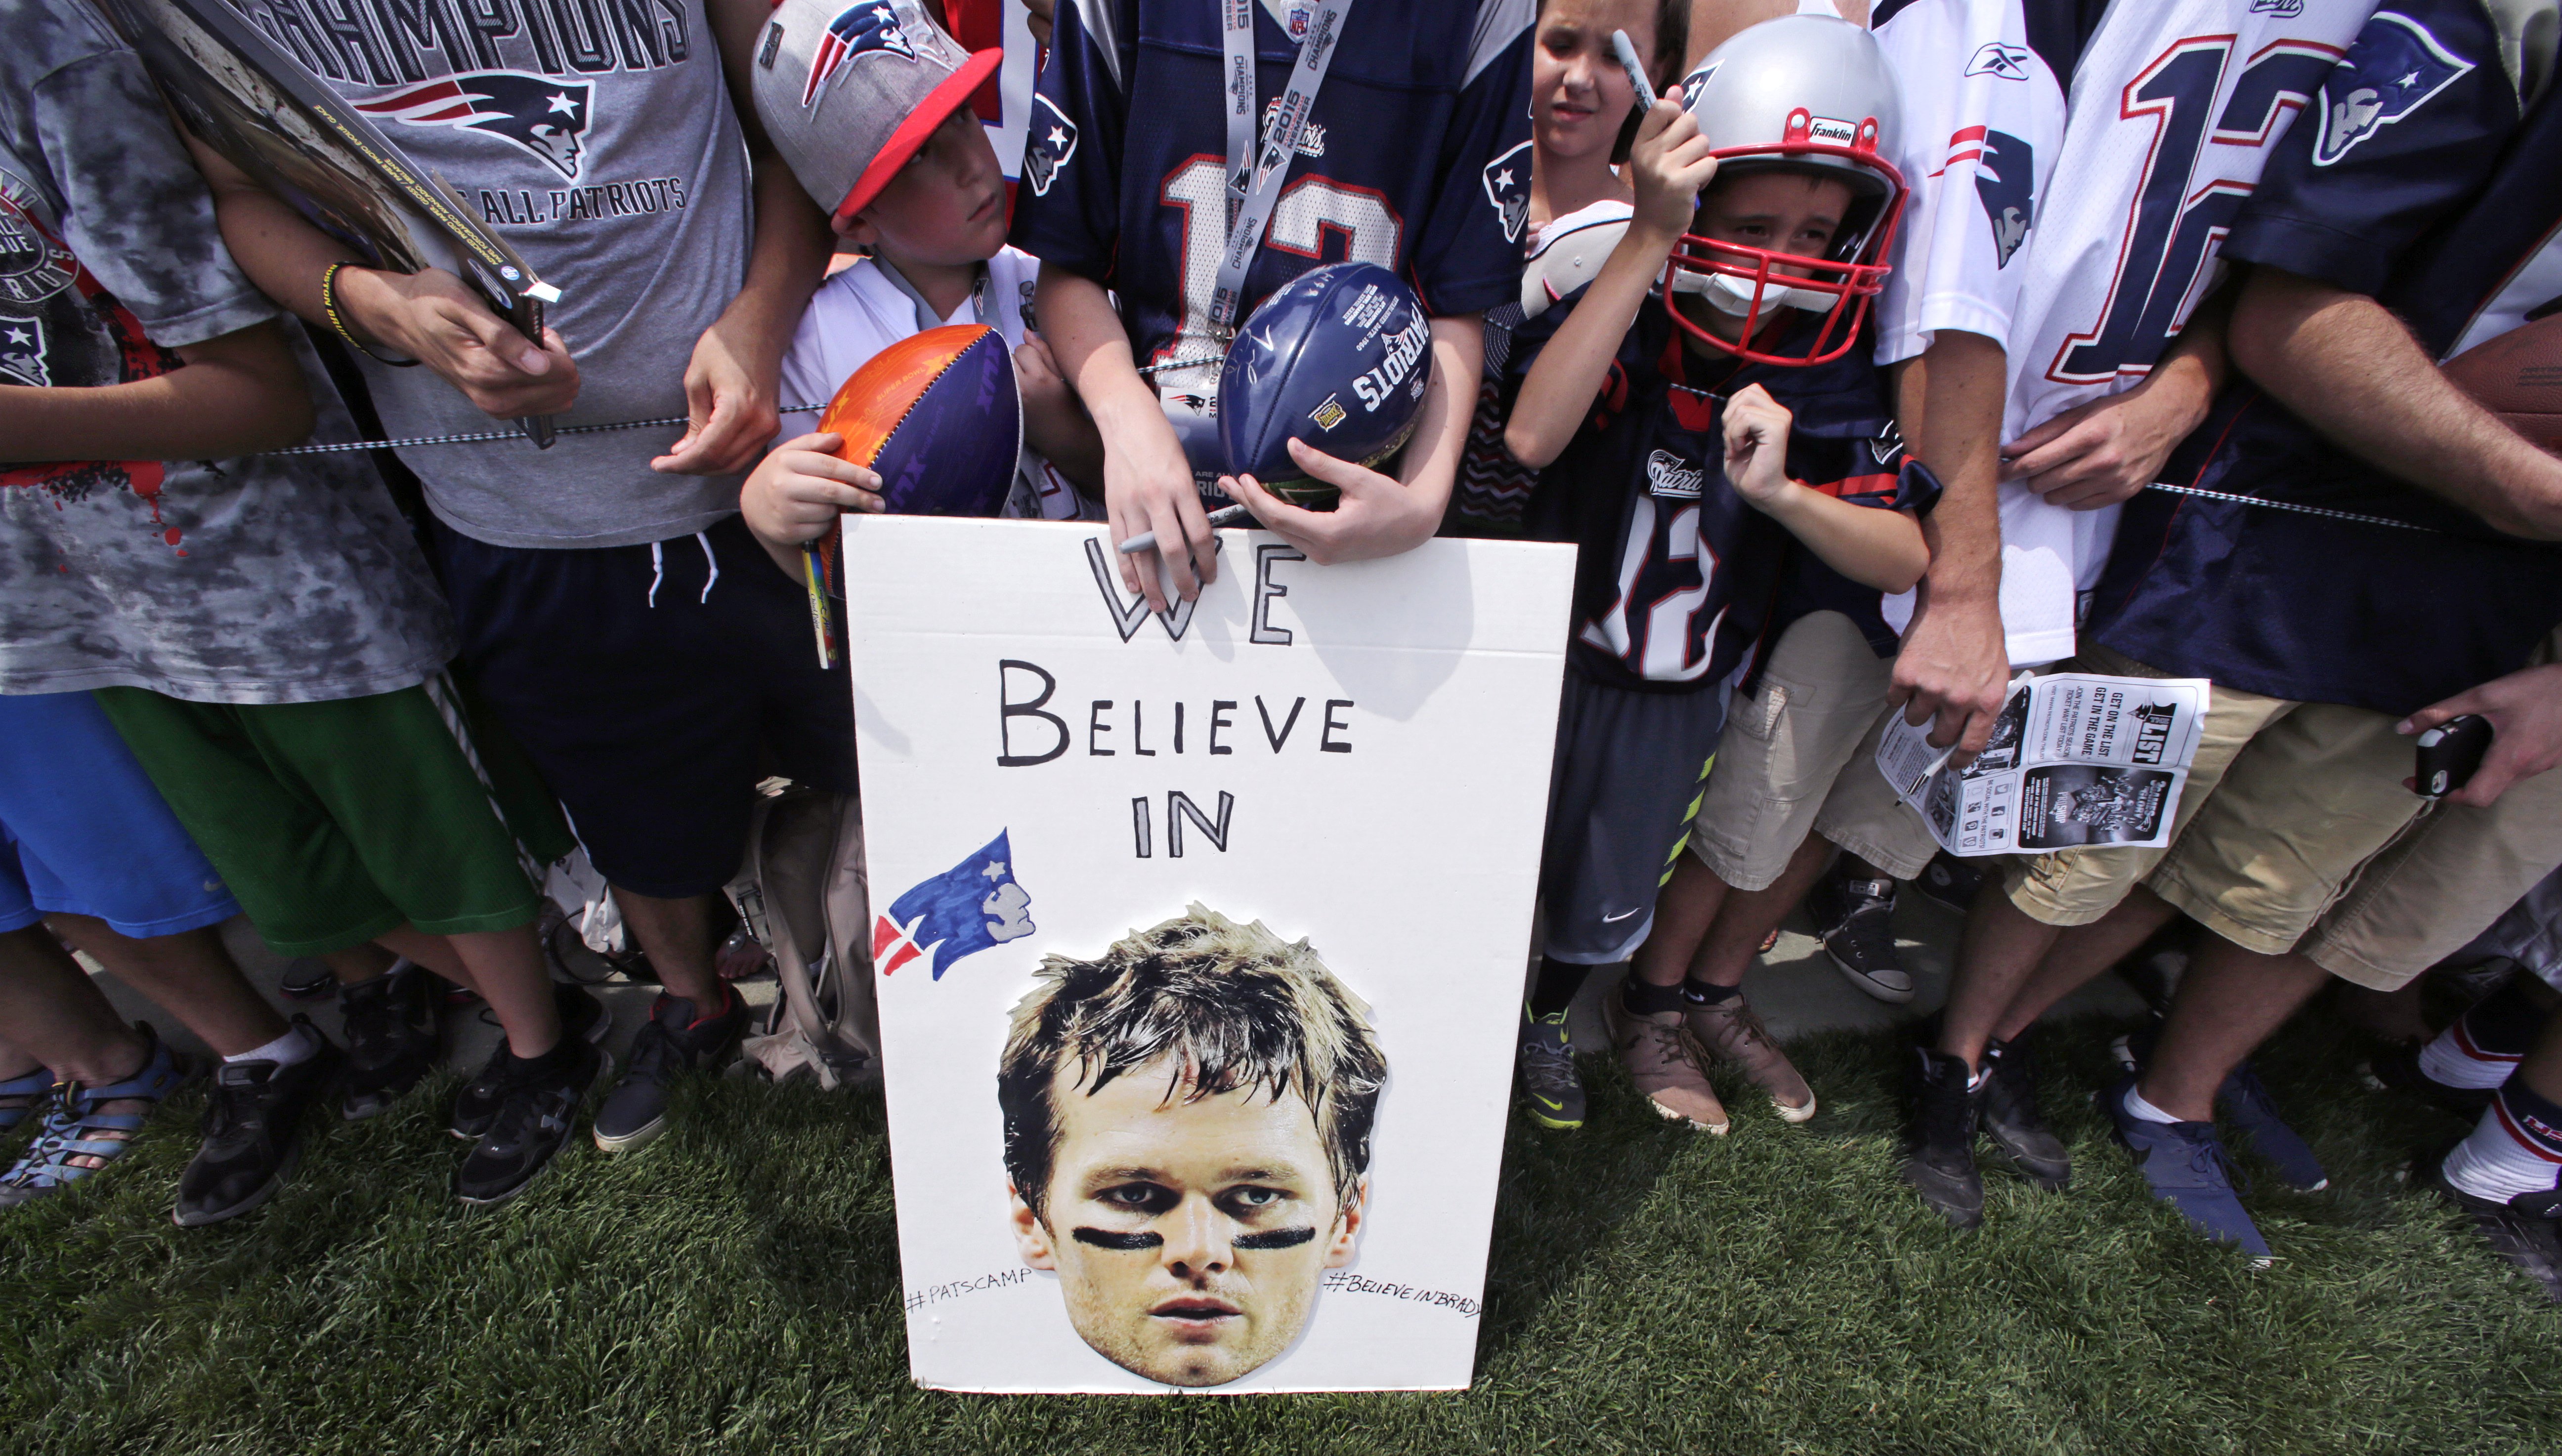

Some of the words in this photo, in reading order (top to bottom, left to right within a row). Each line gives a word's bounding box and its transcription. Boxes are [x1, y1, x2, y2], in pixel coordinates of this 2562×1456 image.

[247, 0, 690, 88] HAMPIONS
[1307, 9, 1337, 71] CHAMPIONS
[1234, 55, 1246, 116] CHAMPIONS
[1273, 89, 1300, 144] 2015
[1287, 96, 1311, 149] MEMBER
[1810, 123, 1852, 141] Franklin
[361, 145, 383, 164] PHOTO
[381, 163, 402, 181] PAPIER
[384, 158, 414, 184] BRILLANTE
[406, 185, 428, 205] GLOSSY
[548, 177, 686, 220] PATRIOTS
[447, 221, 467, 239] PHOTO
[1232, 216, 1257, 270] CHAMPIONS
[467, 238, 497, 265] ADVANCED
[487, 249, 503, 262] PAPEL
[1379, 296, 1400, 325] ESTABLISHED
[1352, 302, 1430, 412] PATRIOTS
[1356, 337, 1369, 351] 1960
[876, 380, 903, 402] SUPER
[902, 367, 926, 383] BOWL
[1084, 537, 1306, 645] WE
[1580, 494, 1730, 682] 12
[2065, 689, 2074, 708] TICKET
[2093, 687, 2106, 703] GET
[2111, 692, 2123, 709] GET
[997, 659, 1355, 767] BELIEVE
[2068, 709, 2079, 736] PATRIOTS
[2091, 704, 2103, 715] IN
[2109, 710, 2119, 722] ON
[2087, 716, 2100, 732] THE
[2102, 723, 2117, 739] THE
[2063, 735, 2073, 758] SEASON
[2081, 732, 2096, 757] GAME.
[2098, 740, 2111, 758] LIST.
[2135, 721, 2169, 763] LIST
[1132, 790, 1234, 858] IN
[906, 1267, 1033, 1314] #PATSCAMP
[1323, 1271, 1483, 1319] #BELIEVEINBRADY
